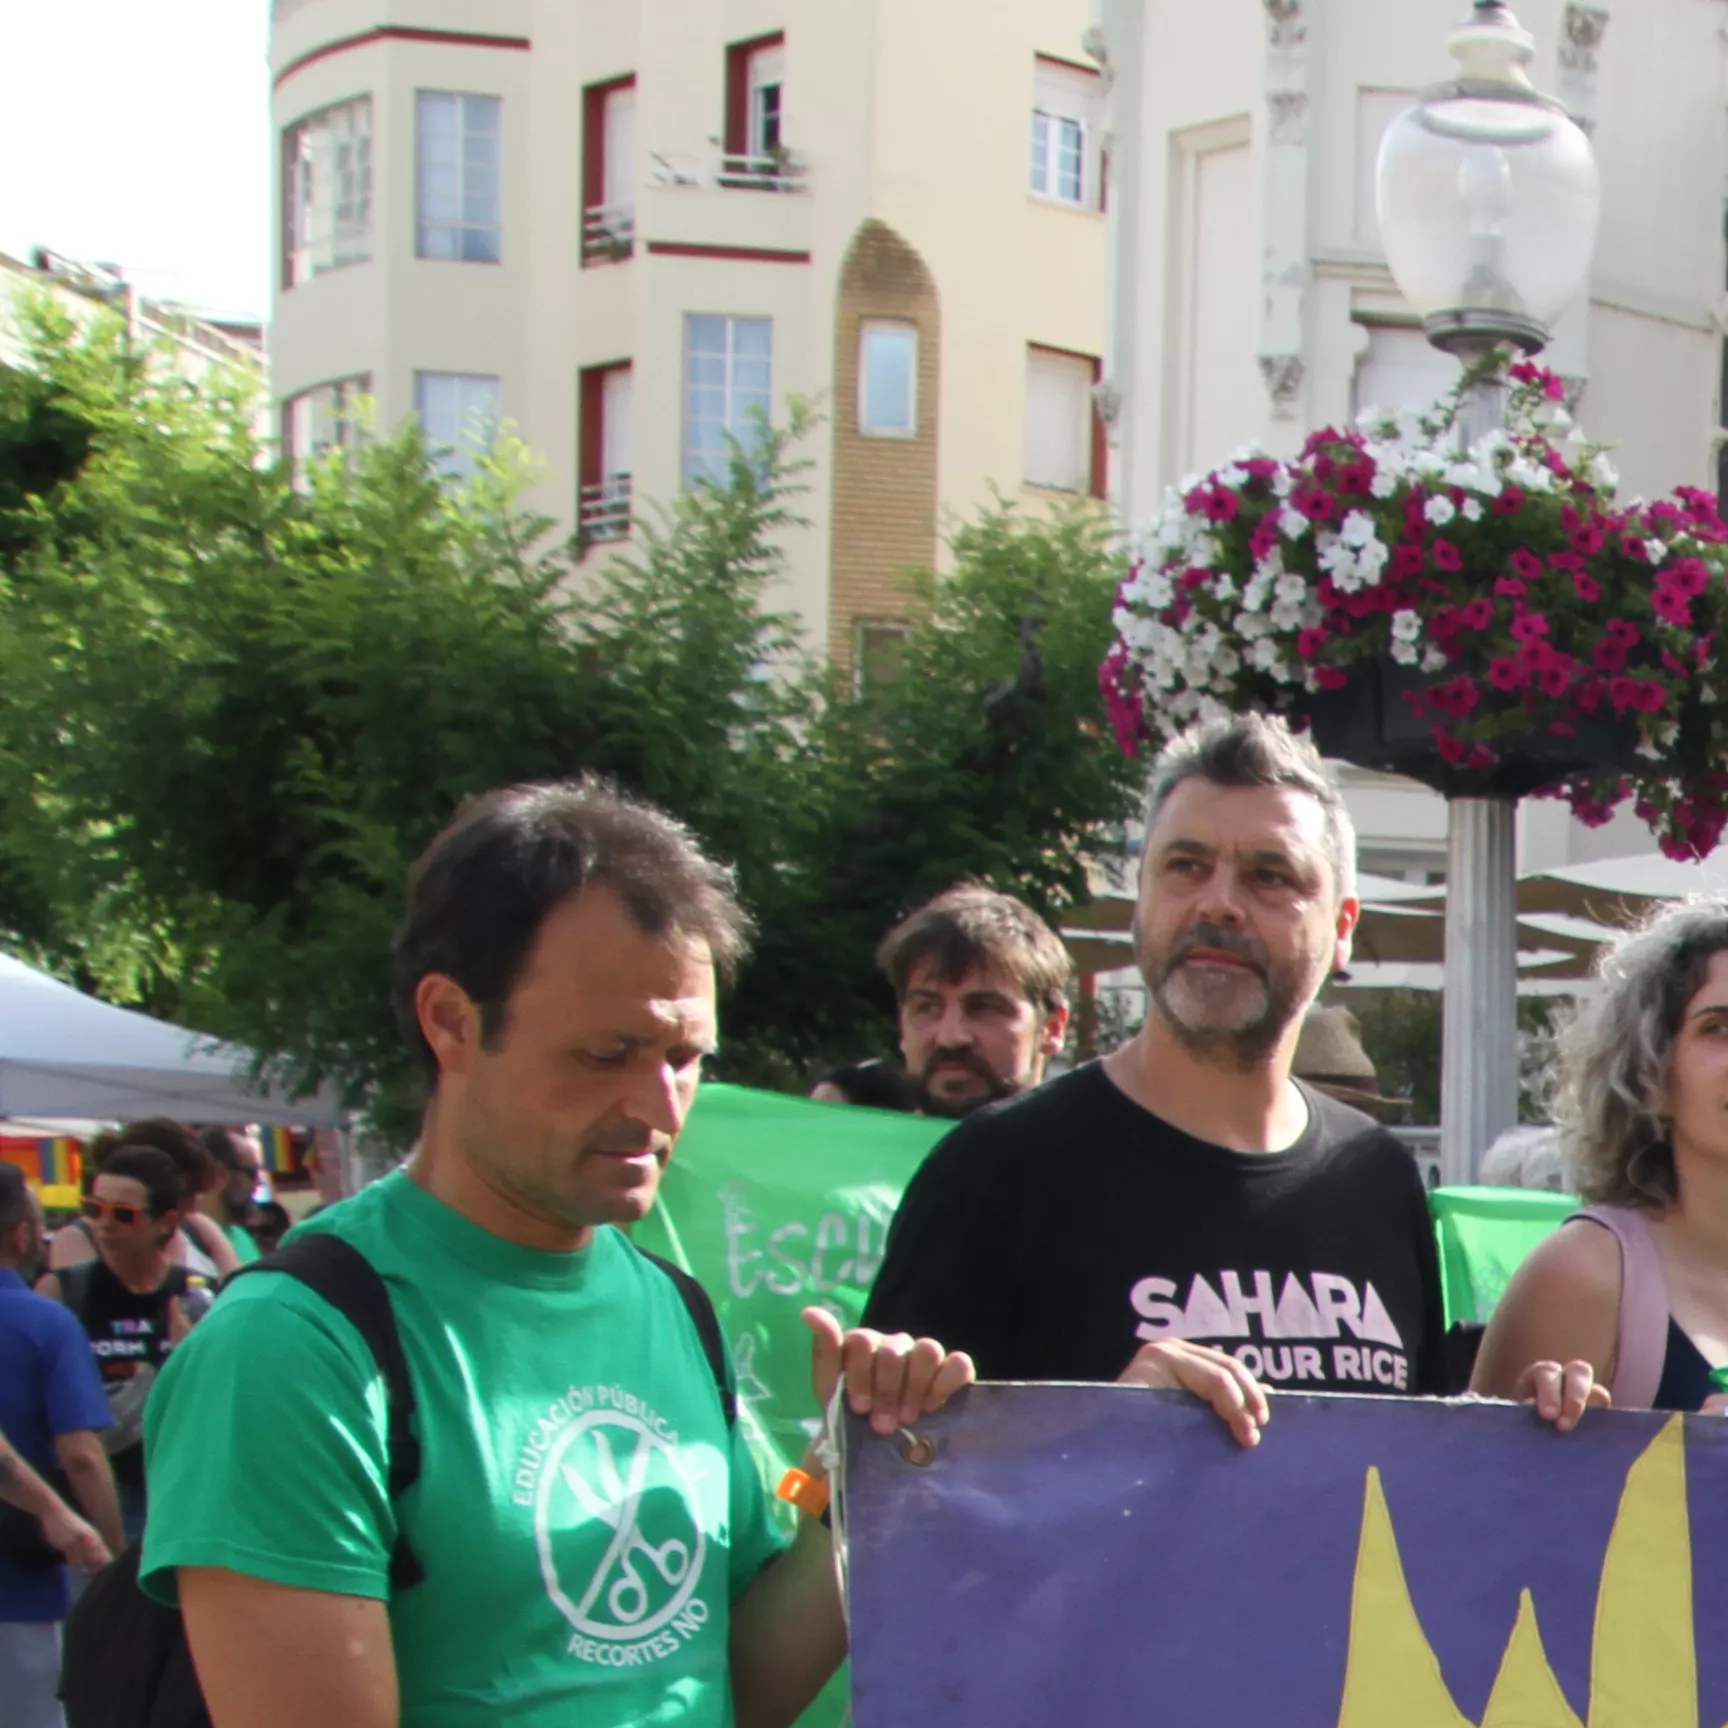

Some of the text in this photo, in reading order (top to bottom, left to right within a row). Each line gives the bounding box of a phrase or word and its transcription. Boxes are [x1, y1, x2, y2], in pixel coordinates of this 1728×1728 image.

[1130, 1270, 1403, 1349] SAHARA
[1332, 1345, 1408, 1390] RICE
[512, 1384, 595, 1507] EDUCACIÓN
[567, 1597, 709, 1667] RECORTES NO
